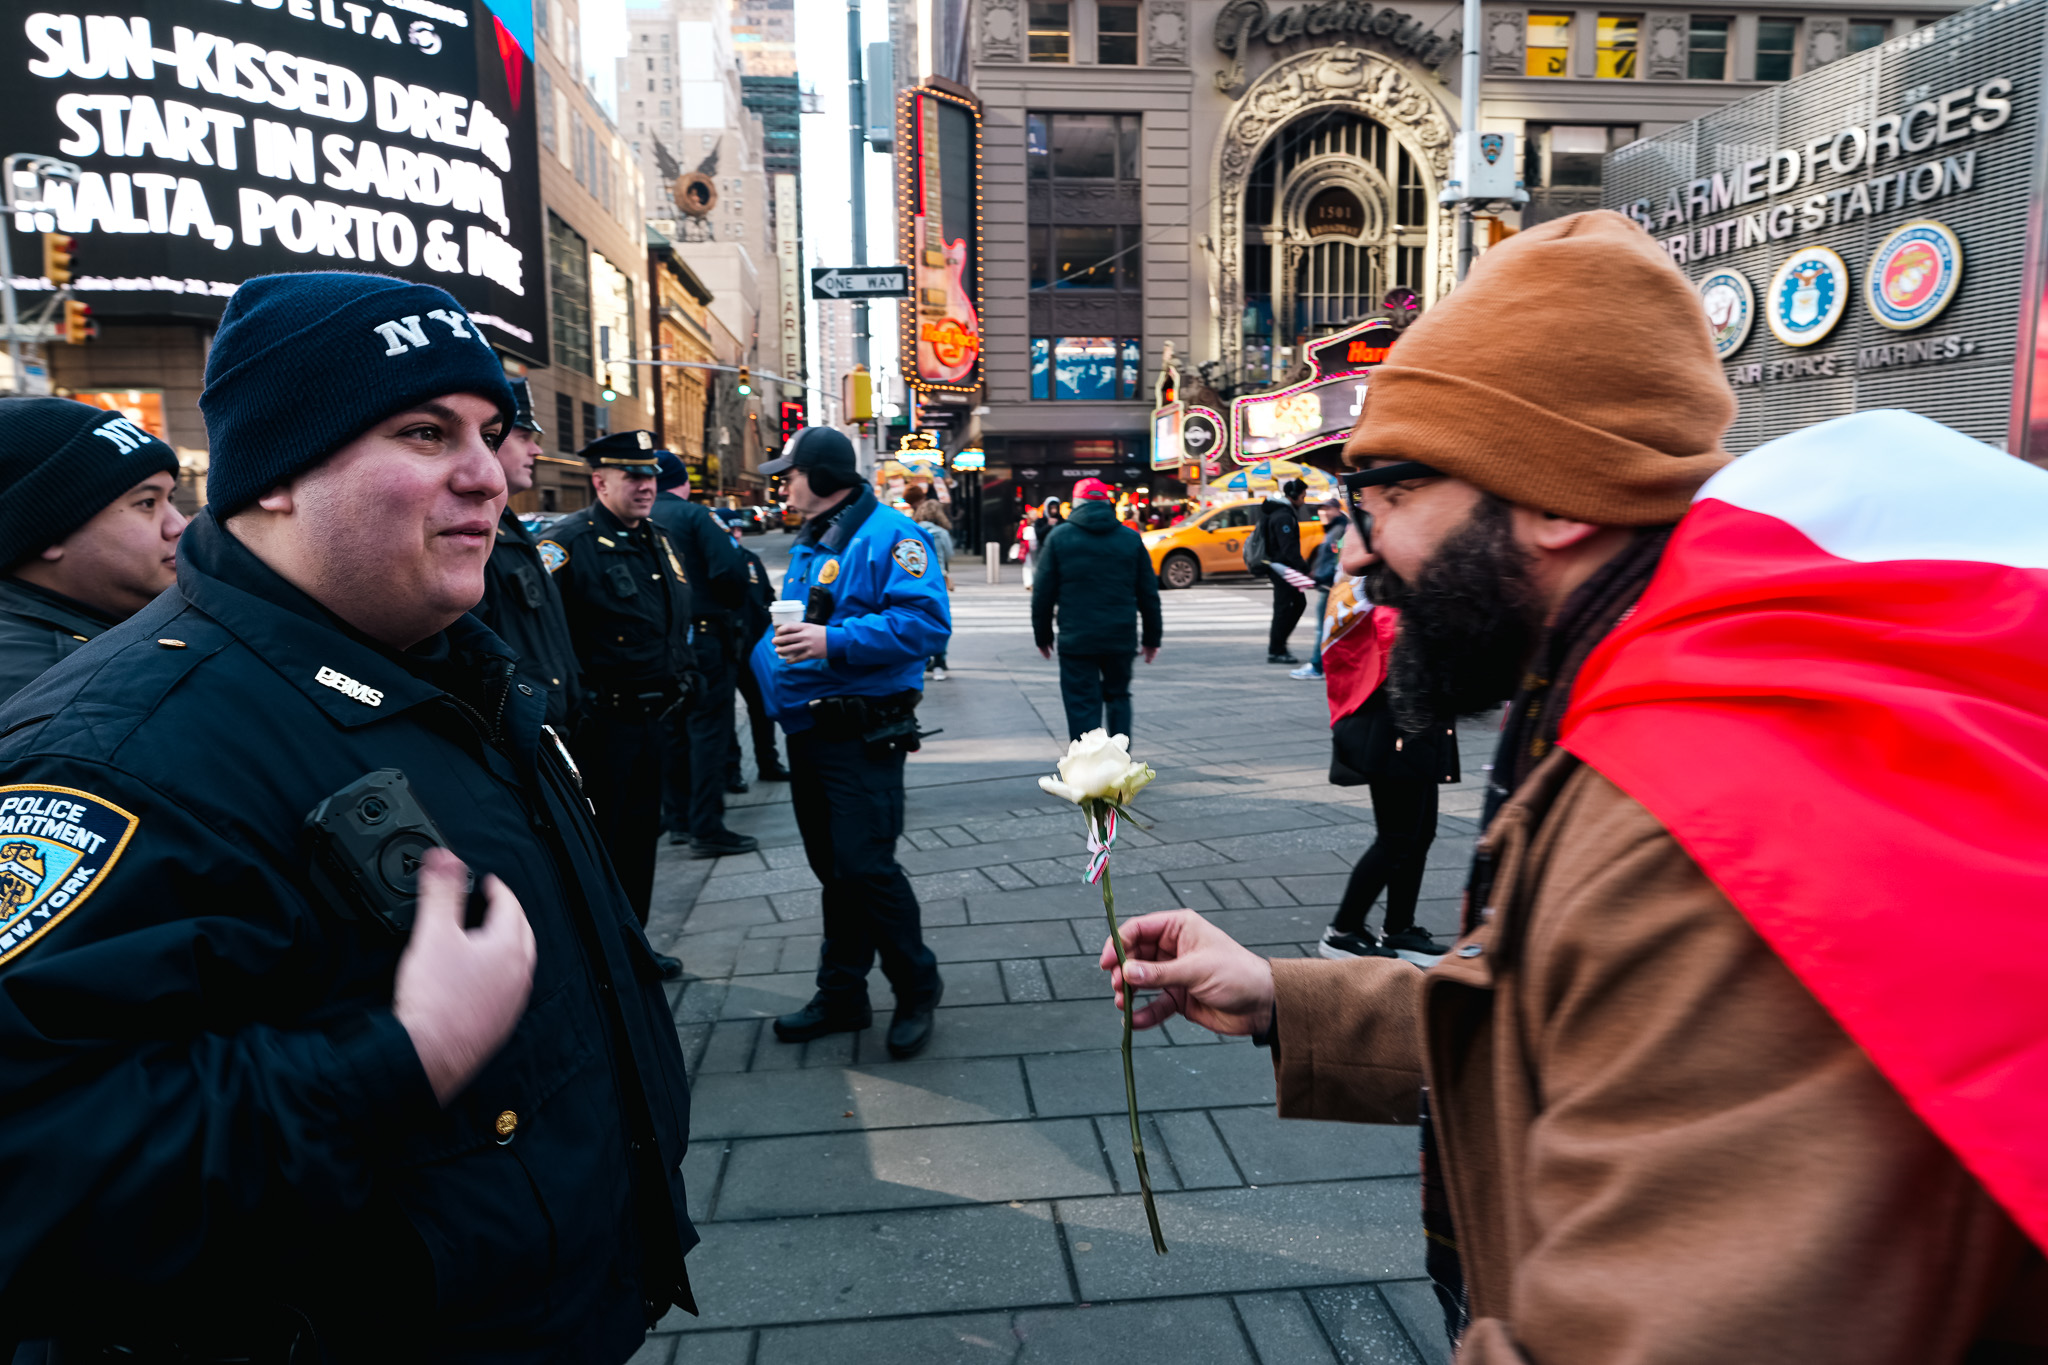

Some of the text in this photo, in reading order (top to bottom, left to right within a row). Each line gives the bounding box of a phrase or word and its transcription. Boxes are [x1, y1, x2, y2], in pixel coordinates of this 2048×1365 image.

[251, 0, 402, 45] ELTA
[25, 12, 368, 124] SUN-KISSED
[56, 93, 245, 171] START
[254, 118, 316, 185] IN
[1660, 148, 1802, 228] ARMED
[1804, 77, 2014, 186] FORCES
[1319, 206, 1351, 219] 1501
[1802, 150, 1977, 231] STATION
[239, 187, 418, 267] PORTO
[423, 219, 461, 273] &
[825, 276, 897, 290] ONE WAY
[373, 308, 491, 357] NY
[1346, 340, 1396, 363] Har
[1732, 335, 1961, 386] AIR FORCE MARINES
[0, 796, 87, 823] POLICE
[0, 866, 97, 955] EW YORK
